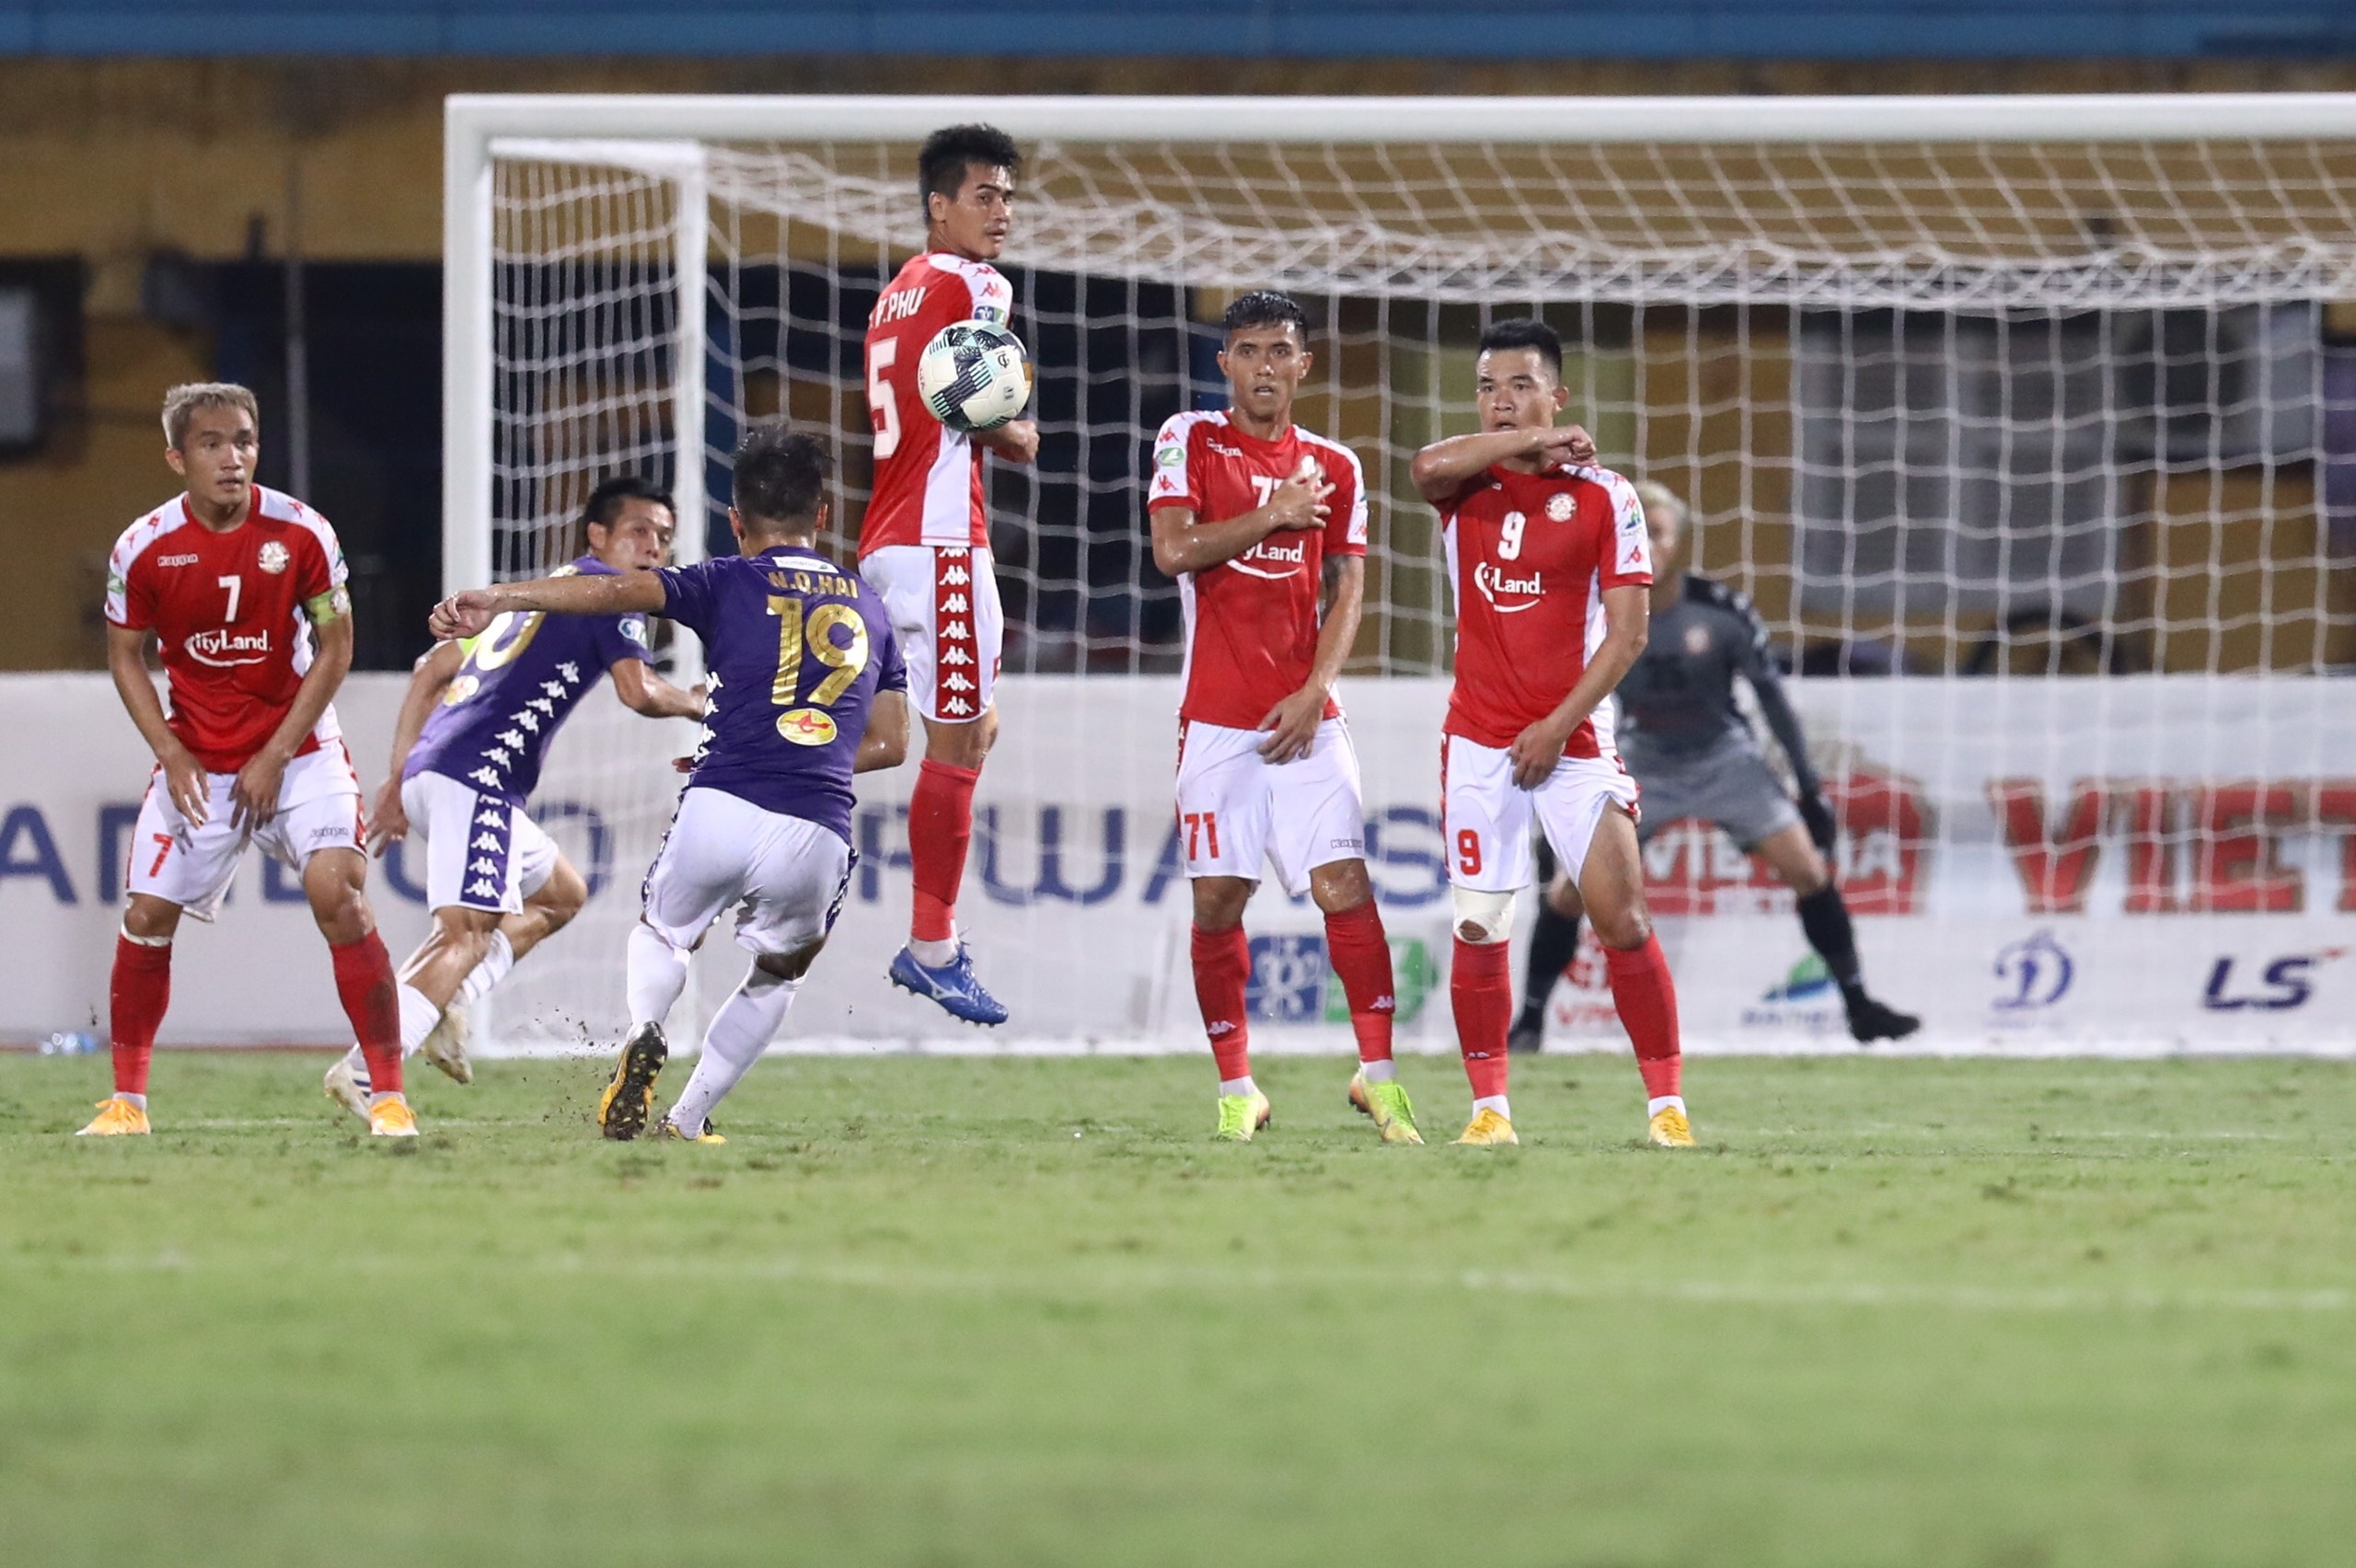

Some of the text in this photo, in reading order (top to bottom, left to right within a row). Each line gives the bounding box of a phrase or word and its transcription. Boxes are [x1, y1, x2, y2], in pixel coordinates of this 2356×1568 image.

[869, 336, 900, 460] 5
[1251, 475, 1284, 509] 7
[1497, 512, 1526, 560] 9
[218, 575, 241, 623] 7
[766, 594, 869, 707] 19
[148, 833, 173, 878] 7
[1184, 812, 1220, 861] 71
[1458, 829, 1482, 876] 9
[2203, 955, 2316, 1010] LS
